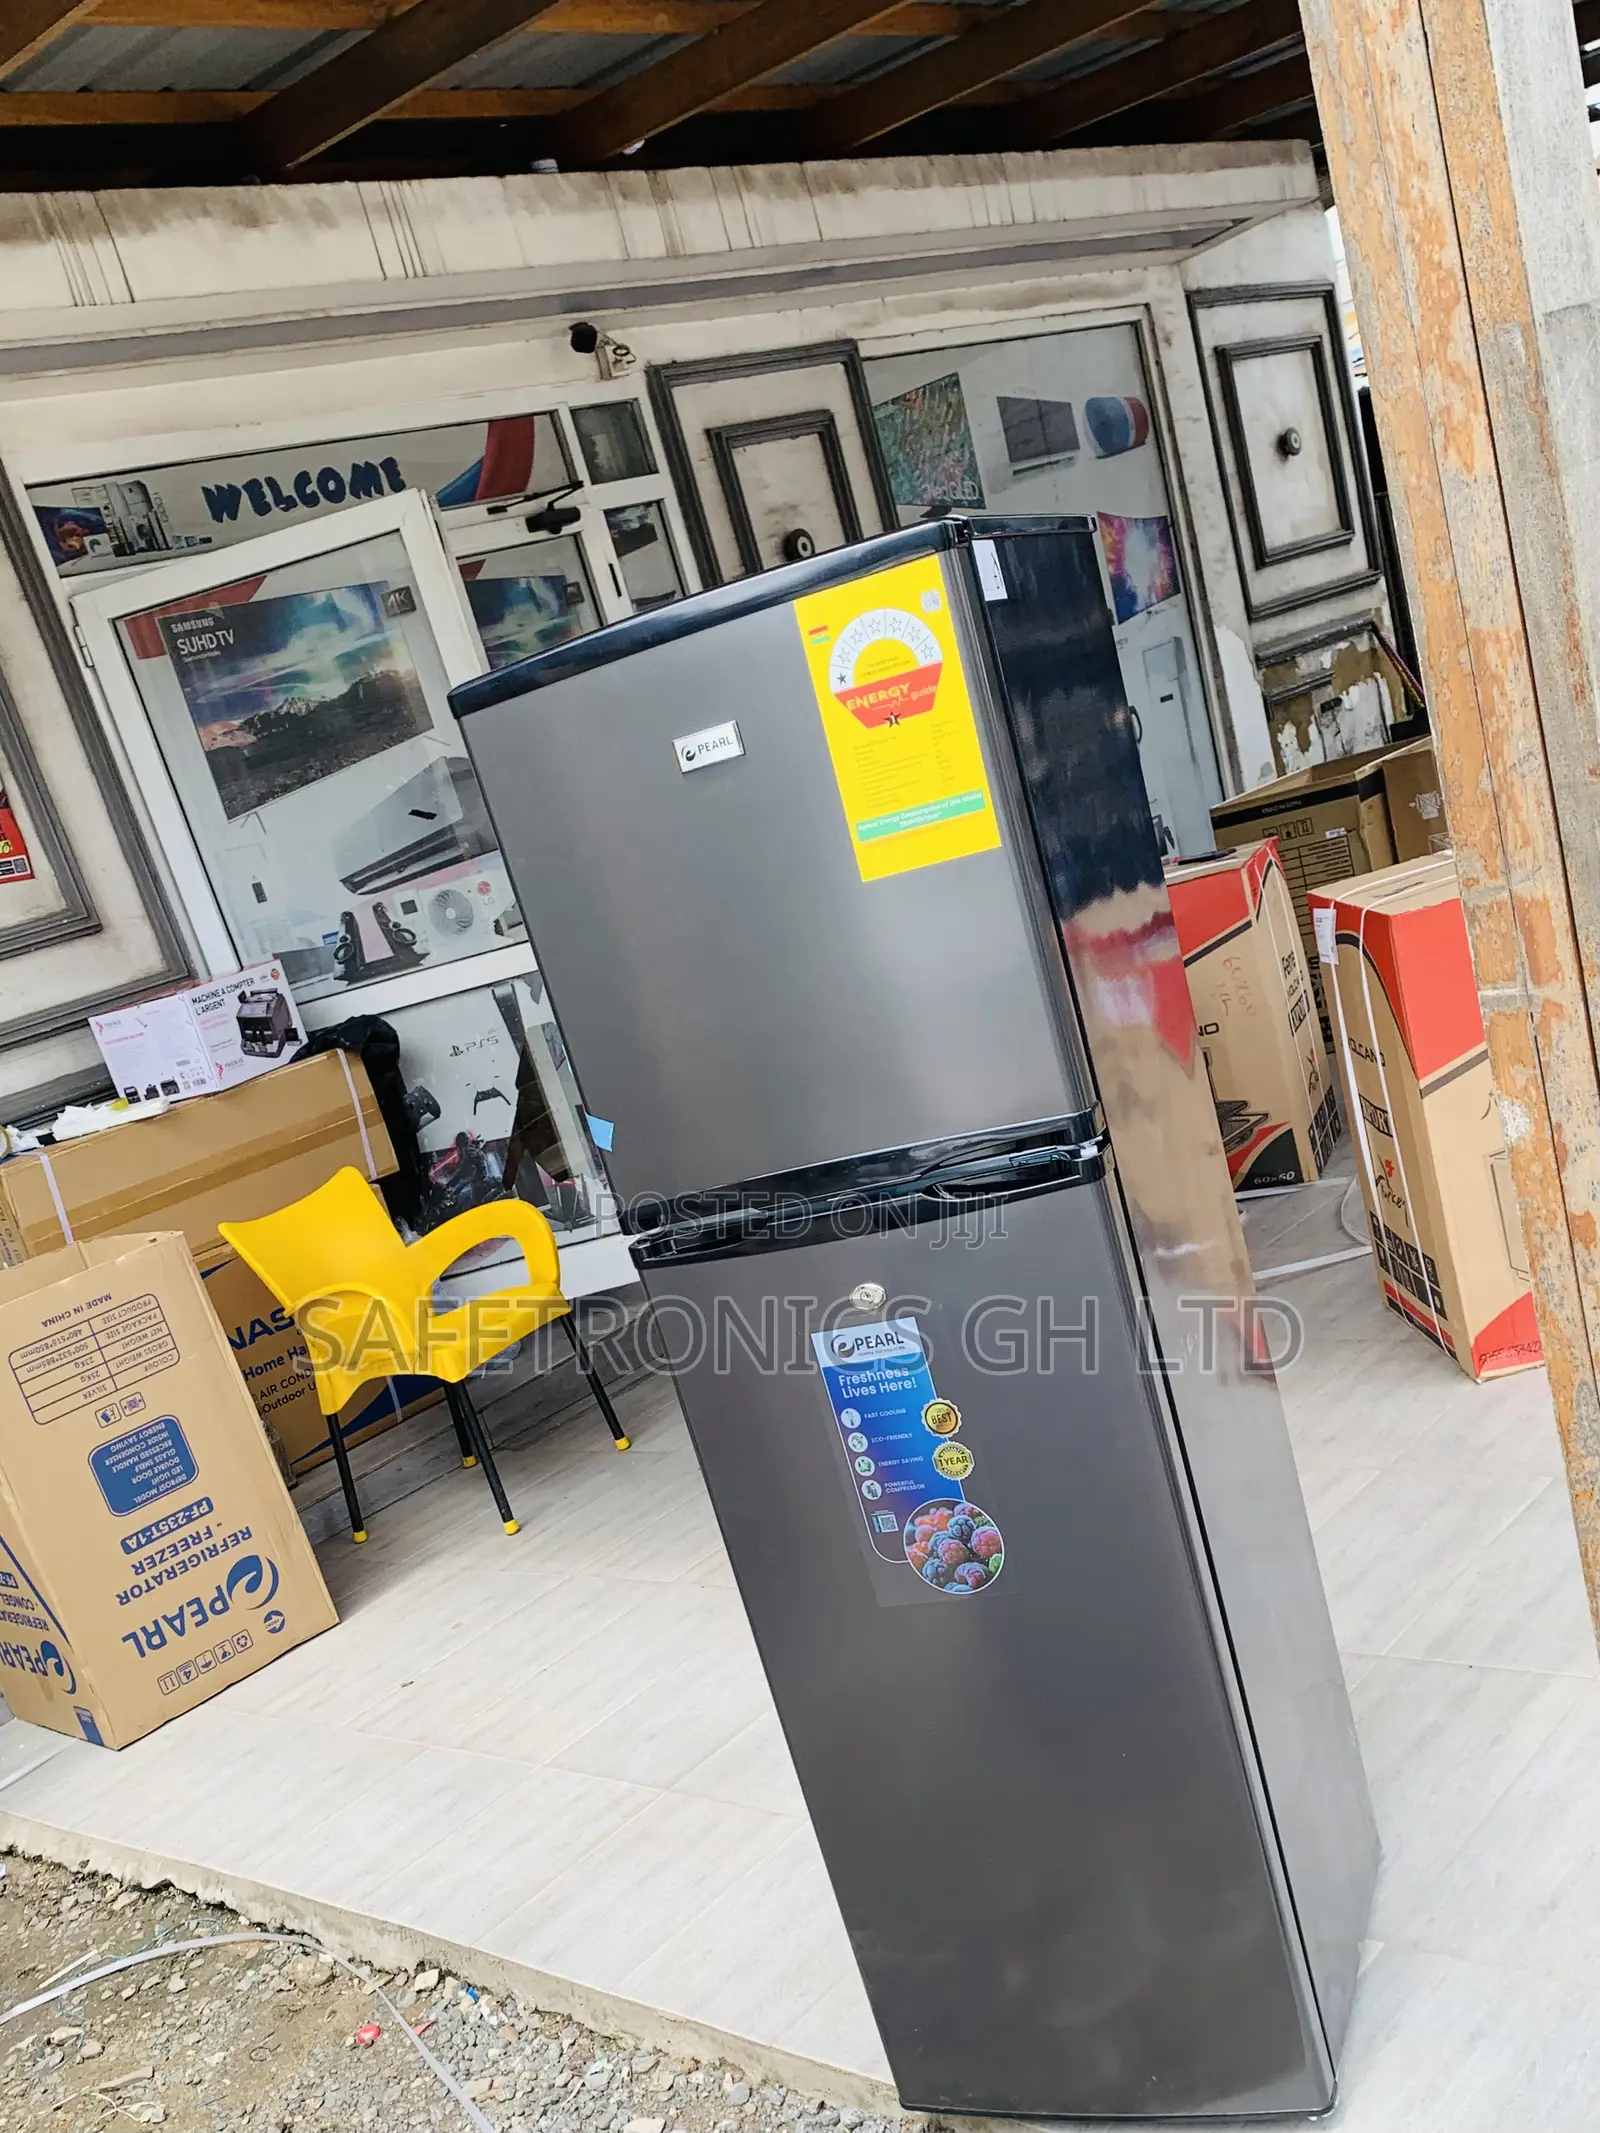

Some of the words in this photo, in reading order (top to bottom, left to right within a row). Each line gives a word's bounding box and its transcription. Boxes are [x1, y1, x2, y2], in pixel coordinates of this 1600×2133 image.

[201, 456, 407, 523] WELCOME
[170, 617, 215, 633] SAMSUNG
[846, 682, 910, 711] ENERGY
[910, 685, 937, 701] guide
[697, 736, 734, 755] PEARL
[191, 989, 221, 1006] MACHINE
[225, 977, 256, 994] COMPTER
[195, 998, 226, 1016] L'ARGENT
[465, 1035, 499, 1052] PS5
[86, 1293, 112, 1306] MADE
[73, 1305, 84, 1315] IN
[41, 1310, 72, 1328] CHINA
[125, 1313, 158, 1330] PACKAGE
[150, 1326, 163, 1337] NET
[144, 1340, 169, 1355] GROSS
[854, 1331, 905, 1351] PEARL
[241, 1355, 286, 1381] Home
[838, 1367, 909, 1387] Freshness
[82, 1384, 108, 1400] SILVER
[260, 1384, 279, 1400] AIR
[841, 1385, 877, 1399] Lives
[879, 1377, 917, 1394] Here!
[262, 1387, 306, 1413] Outdoor
[879, 1408, 907, 1417] COOLING
[931, 1412, 952, 1425] BEST
[139, 1422, 166, 1440] ENERGY
[146, 1431, 169, 1447] INSIDE
[871, 1433, 913, 1444] ECO-FRIENDLY
[110, 1435, 137, 1453] SAVING
[140, 1439, 173, 1459] RECESSED
[104, 1443, 147, 1466] CONDENSER
[155, 1448, 176, 1463] GLASS
[878, 1459, 900, 1468] ENERGY
[901, 1456, 924, 1465] SAVING
[943, 1455, 969, 1467] YEAR
[112, 1456, 139, 1473] HANDLE
[134, 1459, 154, 1473] SHELF
[154, 1456, 180, 1474] DOUBLE
[171, 1465, 184, 1475] LED
[131, 1469, 153, 1484] DOOR
[151, 1472, 171, 1486] LIGHT
[158, 1473, 187, 1492] DEFROST
[884, 1480, 915, 1488] POWERFUL
[133, 1487, 158, 1504] MODEL
[885, 1484, 926, 1494] COMPRESSOR
[124, 1500, 210, 1550] PF-235T-1A
[131, 1525, 214, 1576] FREEZER
[115, 1526, 253, 1606] REFRIGERATOR
[121, 1584, 230, 1658] PEARL
